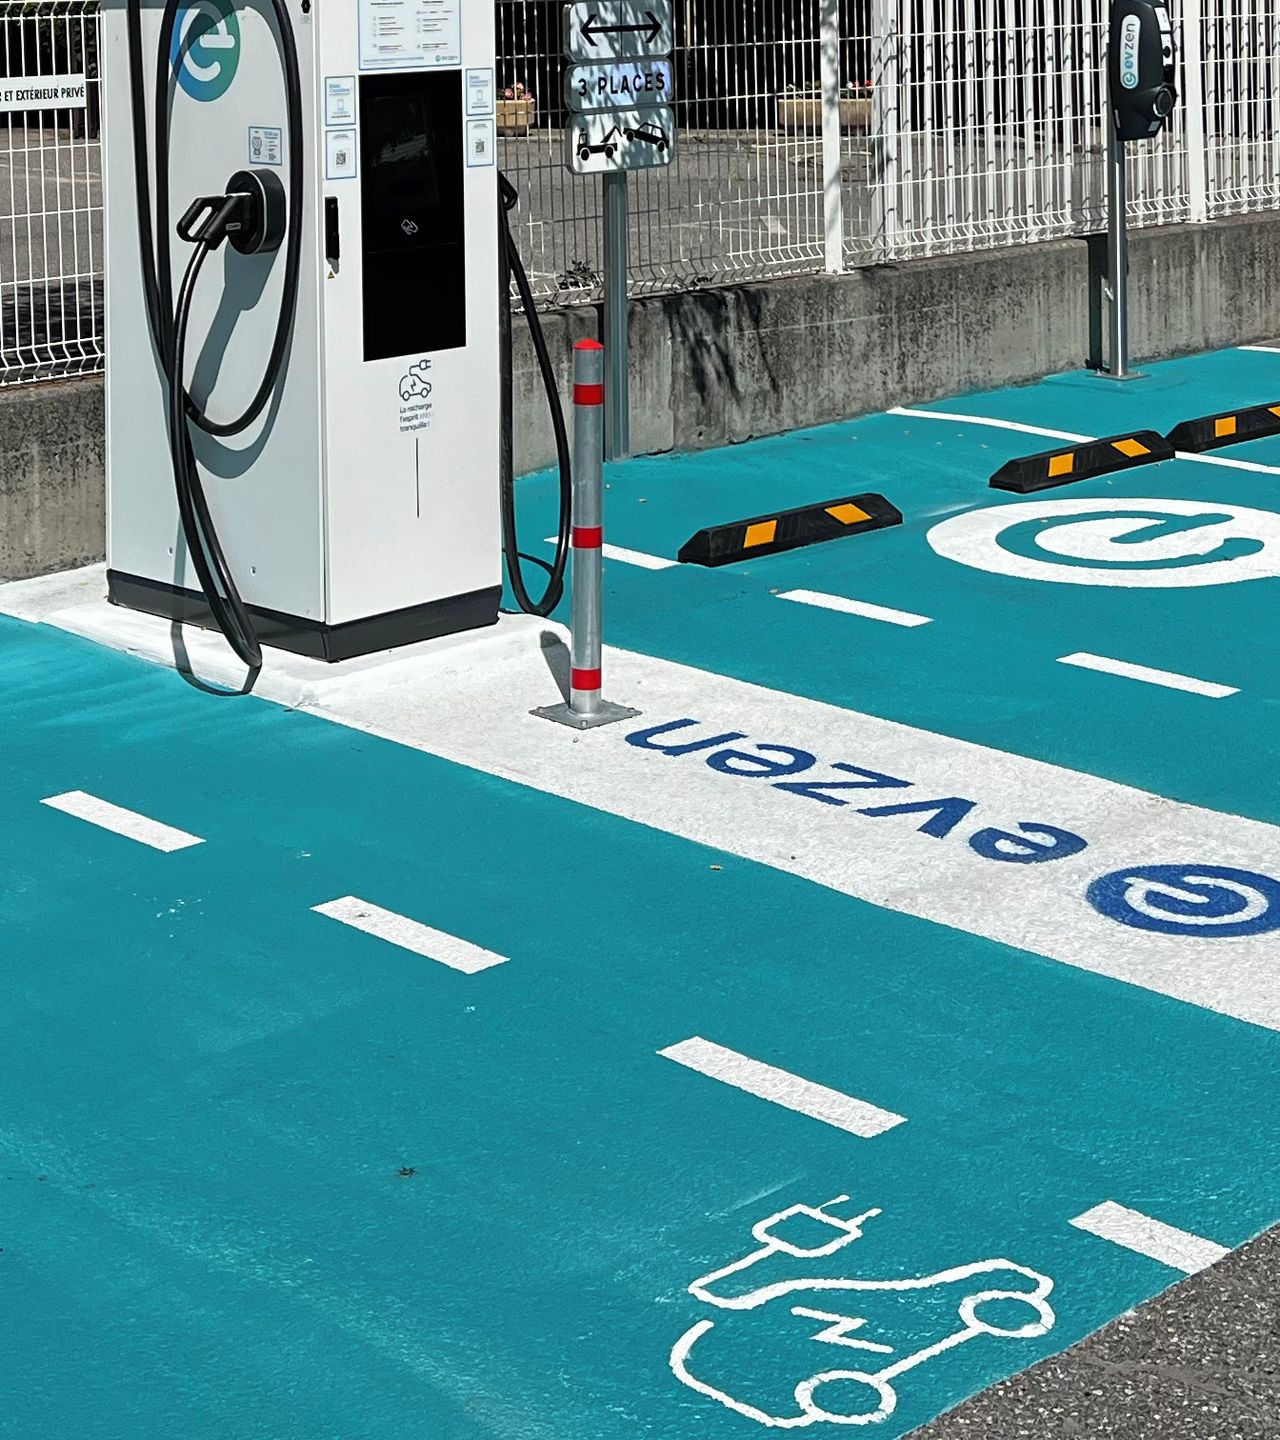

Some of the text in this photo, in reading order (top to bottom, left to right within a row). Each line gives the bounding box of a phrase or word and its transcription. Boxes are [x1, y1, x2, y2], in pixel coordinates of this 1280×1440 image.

[1125, 23, 1135, 69] evzen
[4, 91, 14, 102] ET
[16, 85, 59, 101] EXTÉRIEUR
[61, 83, 85, 98] PRIVÉ
[578, 72, 666, 97] 3 PLACES
[624, 718, 1088, 863] evzen
